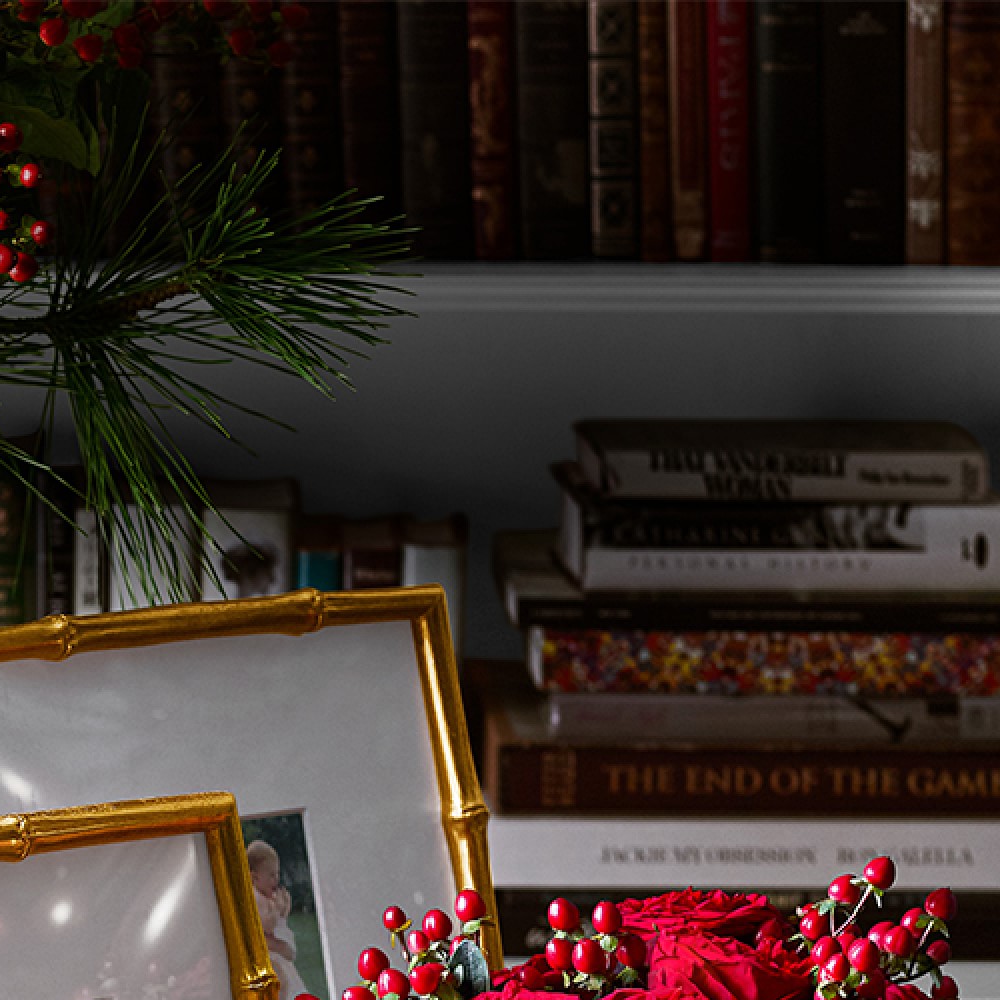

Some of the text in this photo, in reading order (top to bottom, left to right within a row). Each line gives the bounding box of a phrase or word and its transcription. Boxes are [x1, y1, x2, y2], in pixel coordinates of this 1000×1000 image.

[604, 765, 675, 795] THE
[682, 765, 763, 795] END
[768, 765, 820, 795] OF
[828, 765, 897, 796] THE
